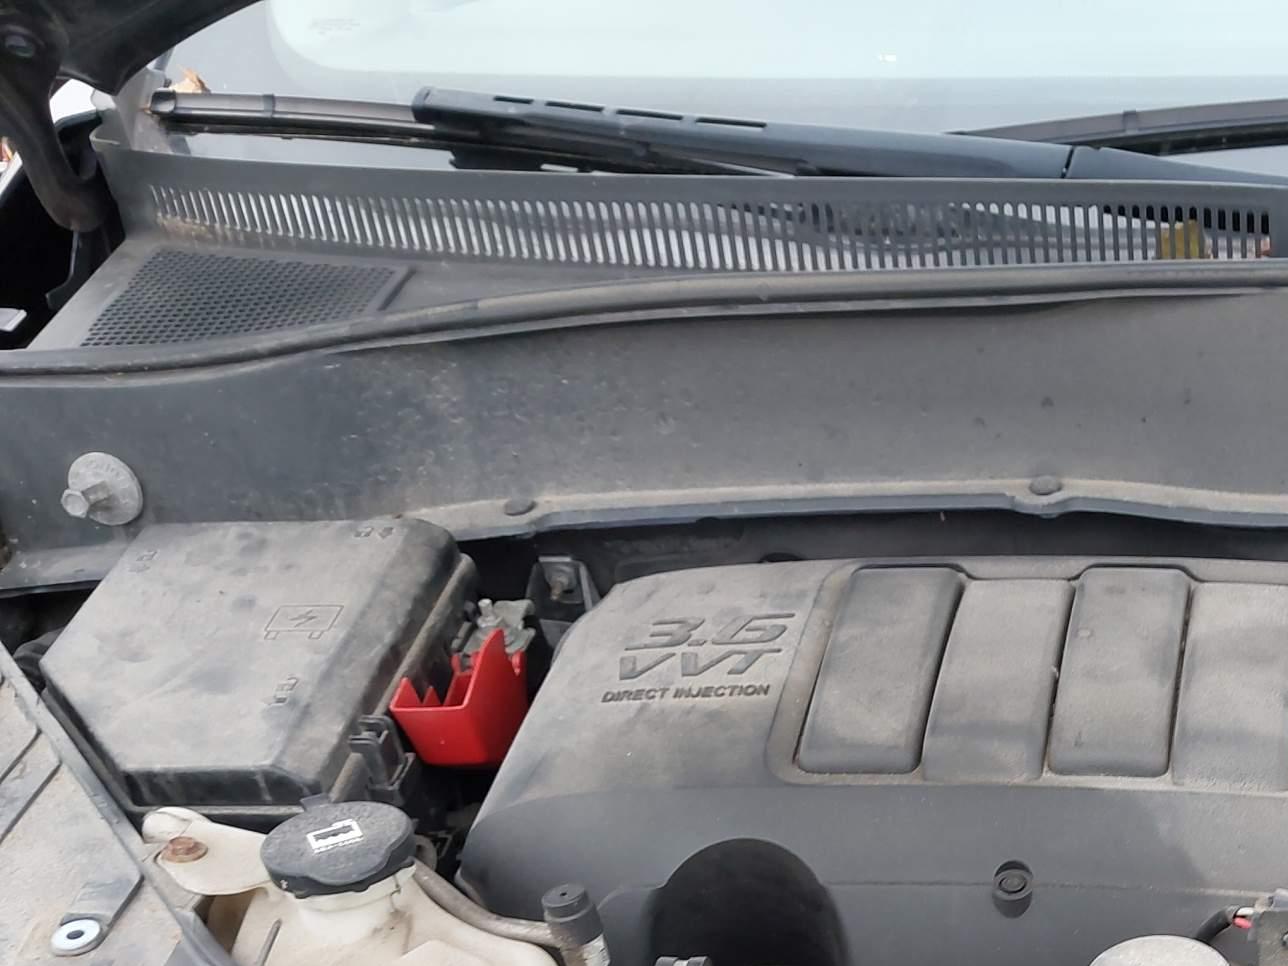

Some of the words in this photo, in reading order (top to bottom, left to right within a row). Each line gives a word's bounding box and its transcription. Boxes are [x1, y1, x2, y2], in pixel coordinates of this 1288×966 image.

[623, 612, 796, 652] 3.6
[619, 648, 782, 680] VVT
[601, 687, 669, 703] DIRECT
[673, 683, 770, 699] INJECTION
